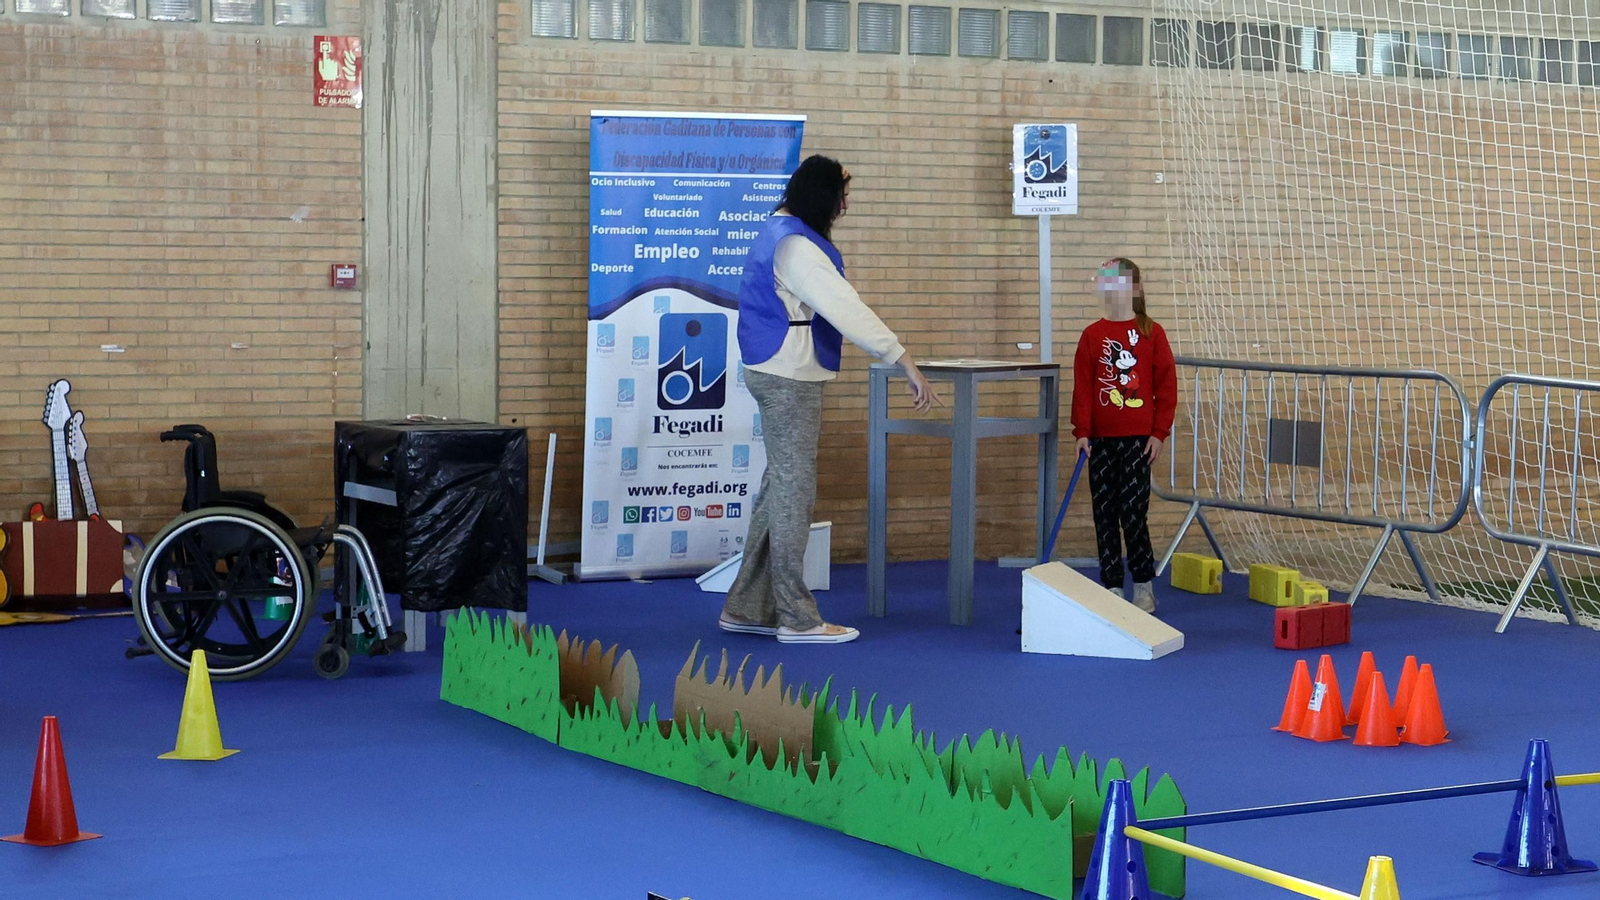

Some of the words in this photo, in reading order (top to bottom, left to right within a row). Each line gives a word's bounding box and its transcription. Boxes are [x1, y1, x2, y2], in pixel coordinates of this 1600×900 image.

[319, 88, 358, 96] PULSADO
[318, 96, 328, 104] DE
[663, 118, 711, 137] Gaditana
[713, 118, 726, 137] de
[727, 120, 776, 138] Personas
[613, 149, 685, 172] Discapacidad
[738, 152, 785, 173] Orgánica
[591, 177, 613, 186] Ocio
[614, 177, 656, 187] Inclusivo
[1154, 172, 1164, 184] 3
[673, 179, 731, 188] Comunicación
[753, 182, 786, 190] Centros
[653, 193, 703, 201] Voluntariado
[1022, 186, 1067, 200] Fegadi
[600, 208, 622, 216] Salud
[644, 207, 700, 218] Educación
[592, 225, 648, 235] Formacion
[654, 227, 692, 235] Atención
[694, 227, 719, 236] Social
[634, 243, 700, 263] Empleo
[712, 246, 751, 256] Rehabil
[591, 263, 634, 275] Deporte
[1098, 337, 1123, 406] Mickey
[652, 414, 723, 439] Fegadi
[667, 448, 713, 458] COCEMFE
[671, 462, 708, 470] encontrarás
[628, 481, 748, 498] www.fegadi.org
[728, 504, 740, 517] in
